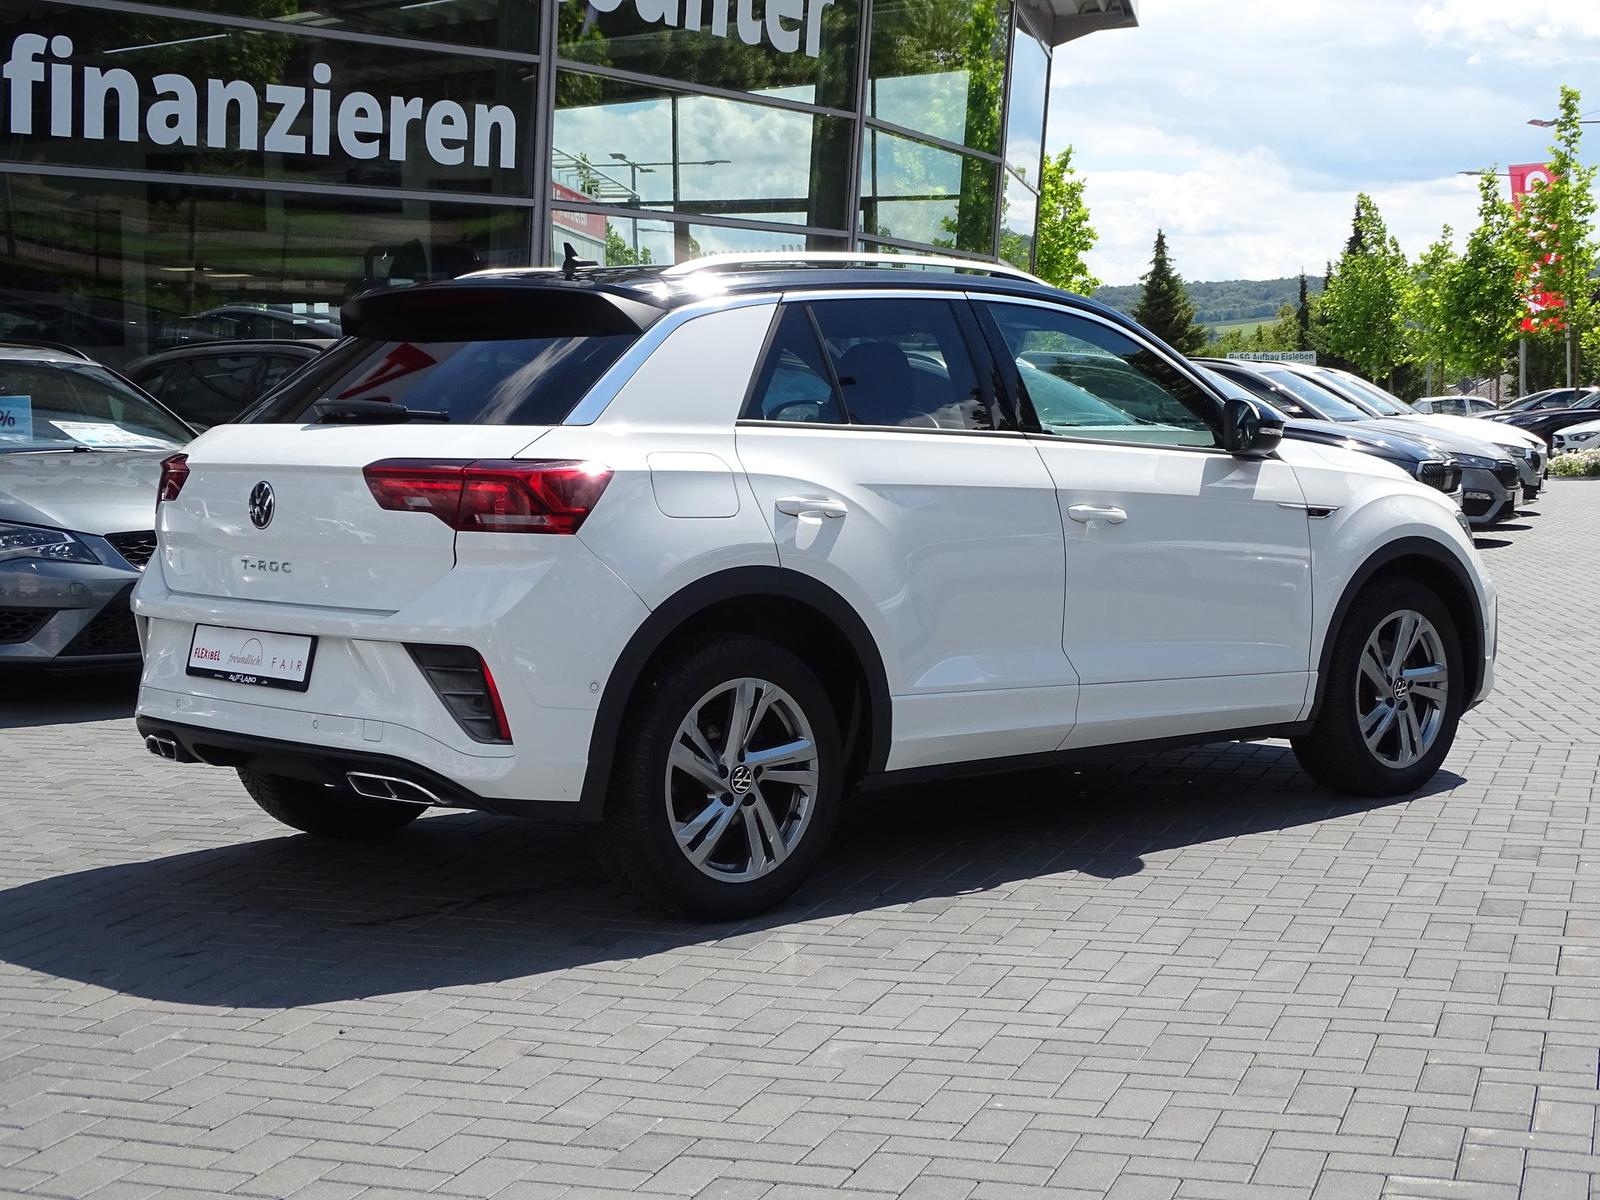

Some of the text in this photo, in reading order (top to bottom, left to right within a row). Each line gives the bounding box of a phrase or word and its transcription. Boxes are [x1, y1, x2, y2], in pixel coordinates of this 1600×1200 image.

[3, 33, 517, 169] finanzieren
[1281, 352, 1314, 360] Eisleben
[240, 559, 293, 574] T-ROC
